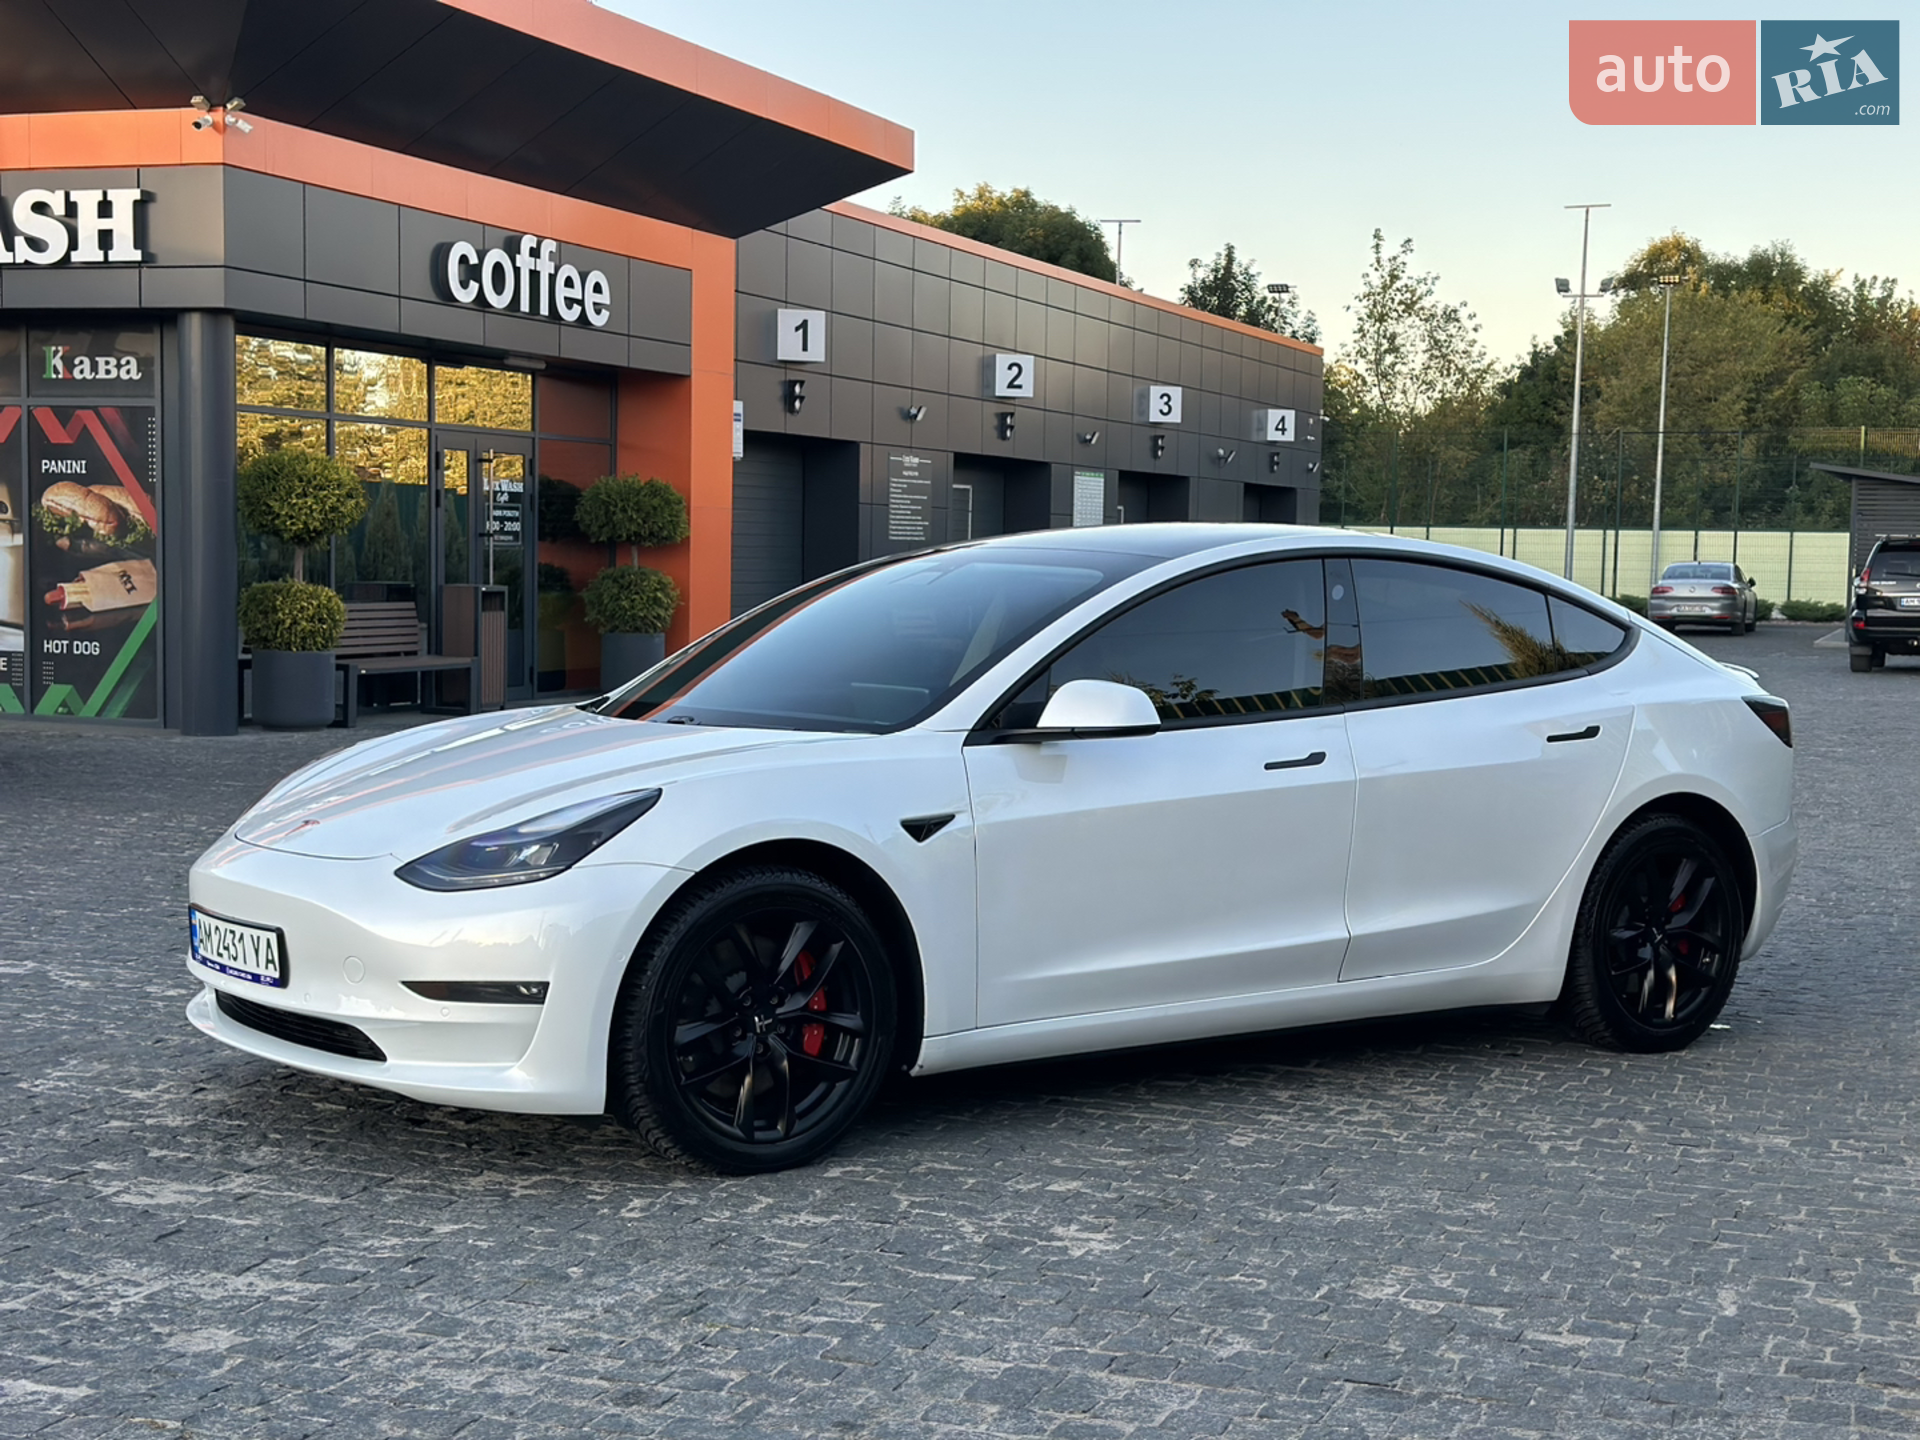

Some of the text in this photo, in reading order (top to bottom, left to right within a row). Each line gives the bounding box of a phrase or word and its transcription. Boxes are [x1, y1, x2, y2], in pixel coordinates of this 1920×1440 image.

[0, 188, 142, 265] SH
[447, 234, 611, 328] coffee
[794, 318, 809, 352] 1
[42, 346, 142, 381] Кава
[1006, 362, 1024, 389] 2
[1158, 392, 1173, 417] 3
[1274, 414, 1288, 436] 4
[41, 459, 87, 475] PANINI
[504, 521, 521, 532] 20:00
[43, 639, 100, 656] HOT DOG
[198, 917, 278, 972] AM 2431 YA
